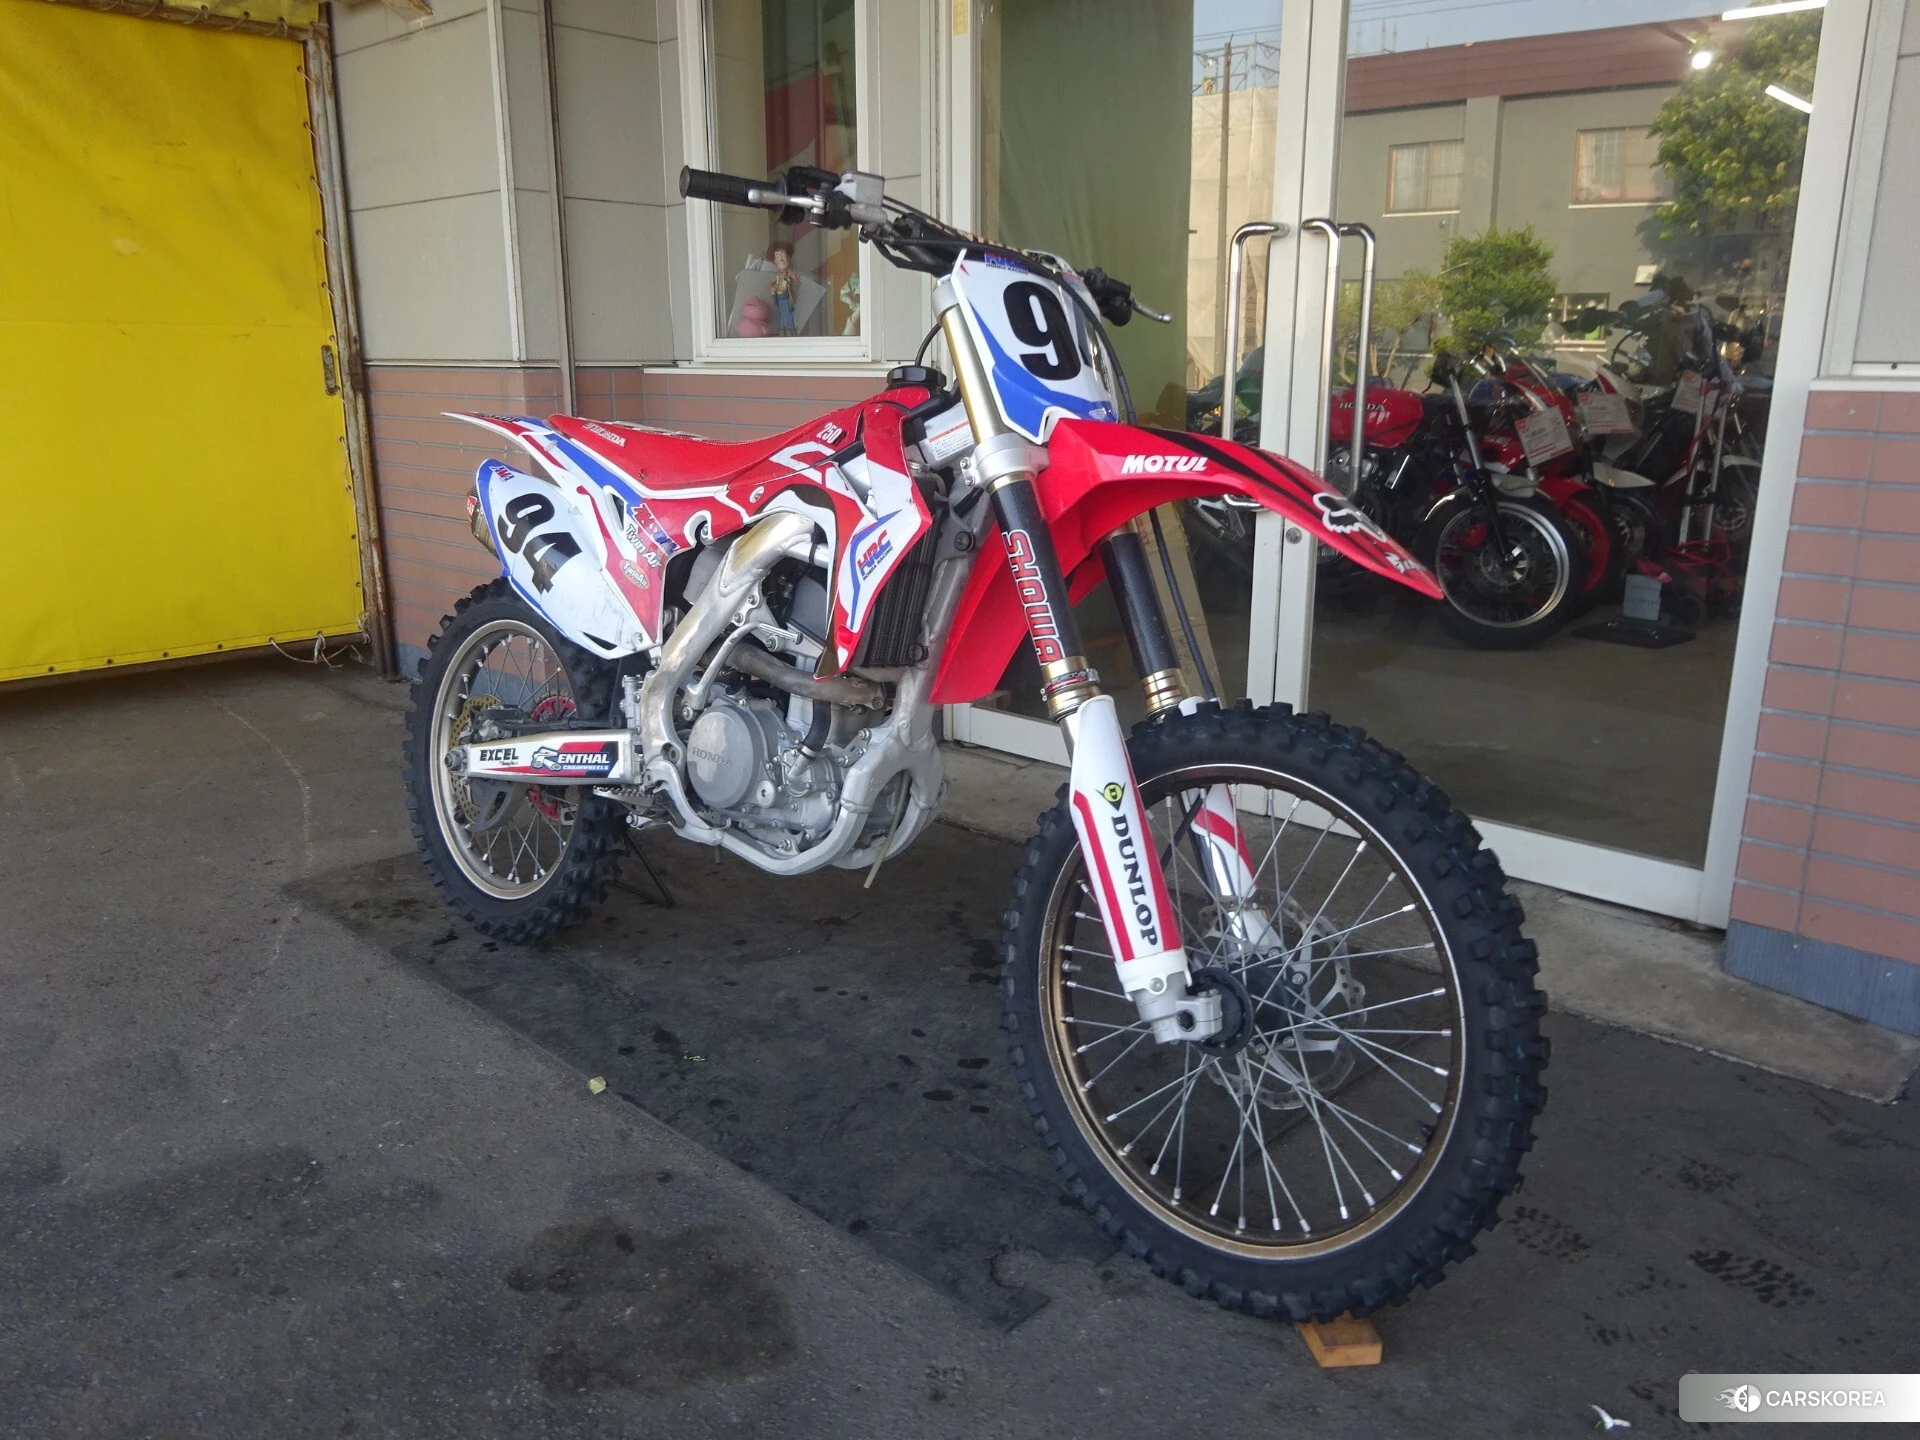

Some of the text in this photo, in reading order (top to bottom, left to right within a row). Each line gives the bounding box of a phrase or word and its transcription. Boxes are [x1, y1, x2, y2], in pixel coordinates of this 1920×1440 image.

[593, 424, 627, 448] HONDA
[816, 422, 842, 443] 250
[1121, 455, 1208, 474] MOTUL
[497, 493, 583, 596] 94
[626, 524, 646, 553] Twin
[857, 529, 891, 577] HRC
[863, 546, 893, 581] HONDA RACING
[1001, 529, 1066, 666] SHOWA
[480, 748, 519, 762] EXCEL
[692, 747, 734, 767] HONDA
[1111, 814, 1158, 946] DUNLOP
